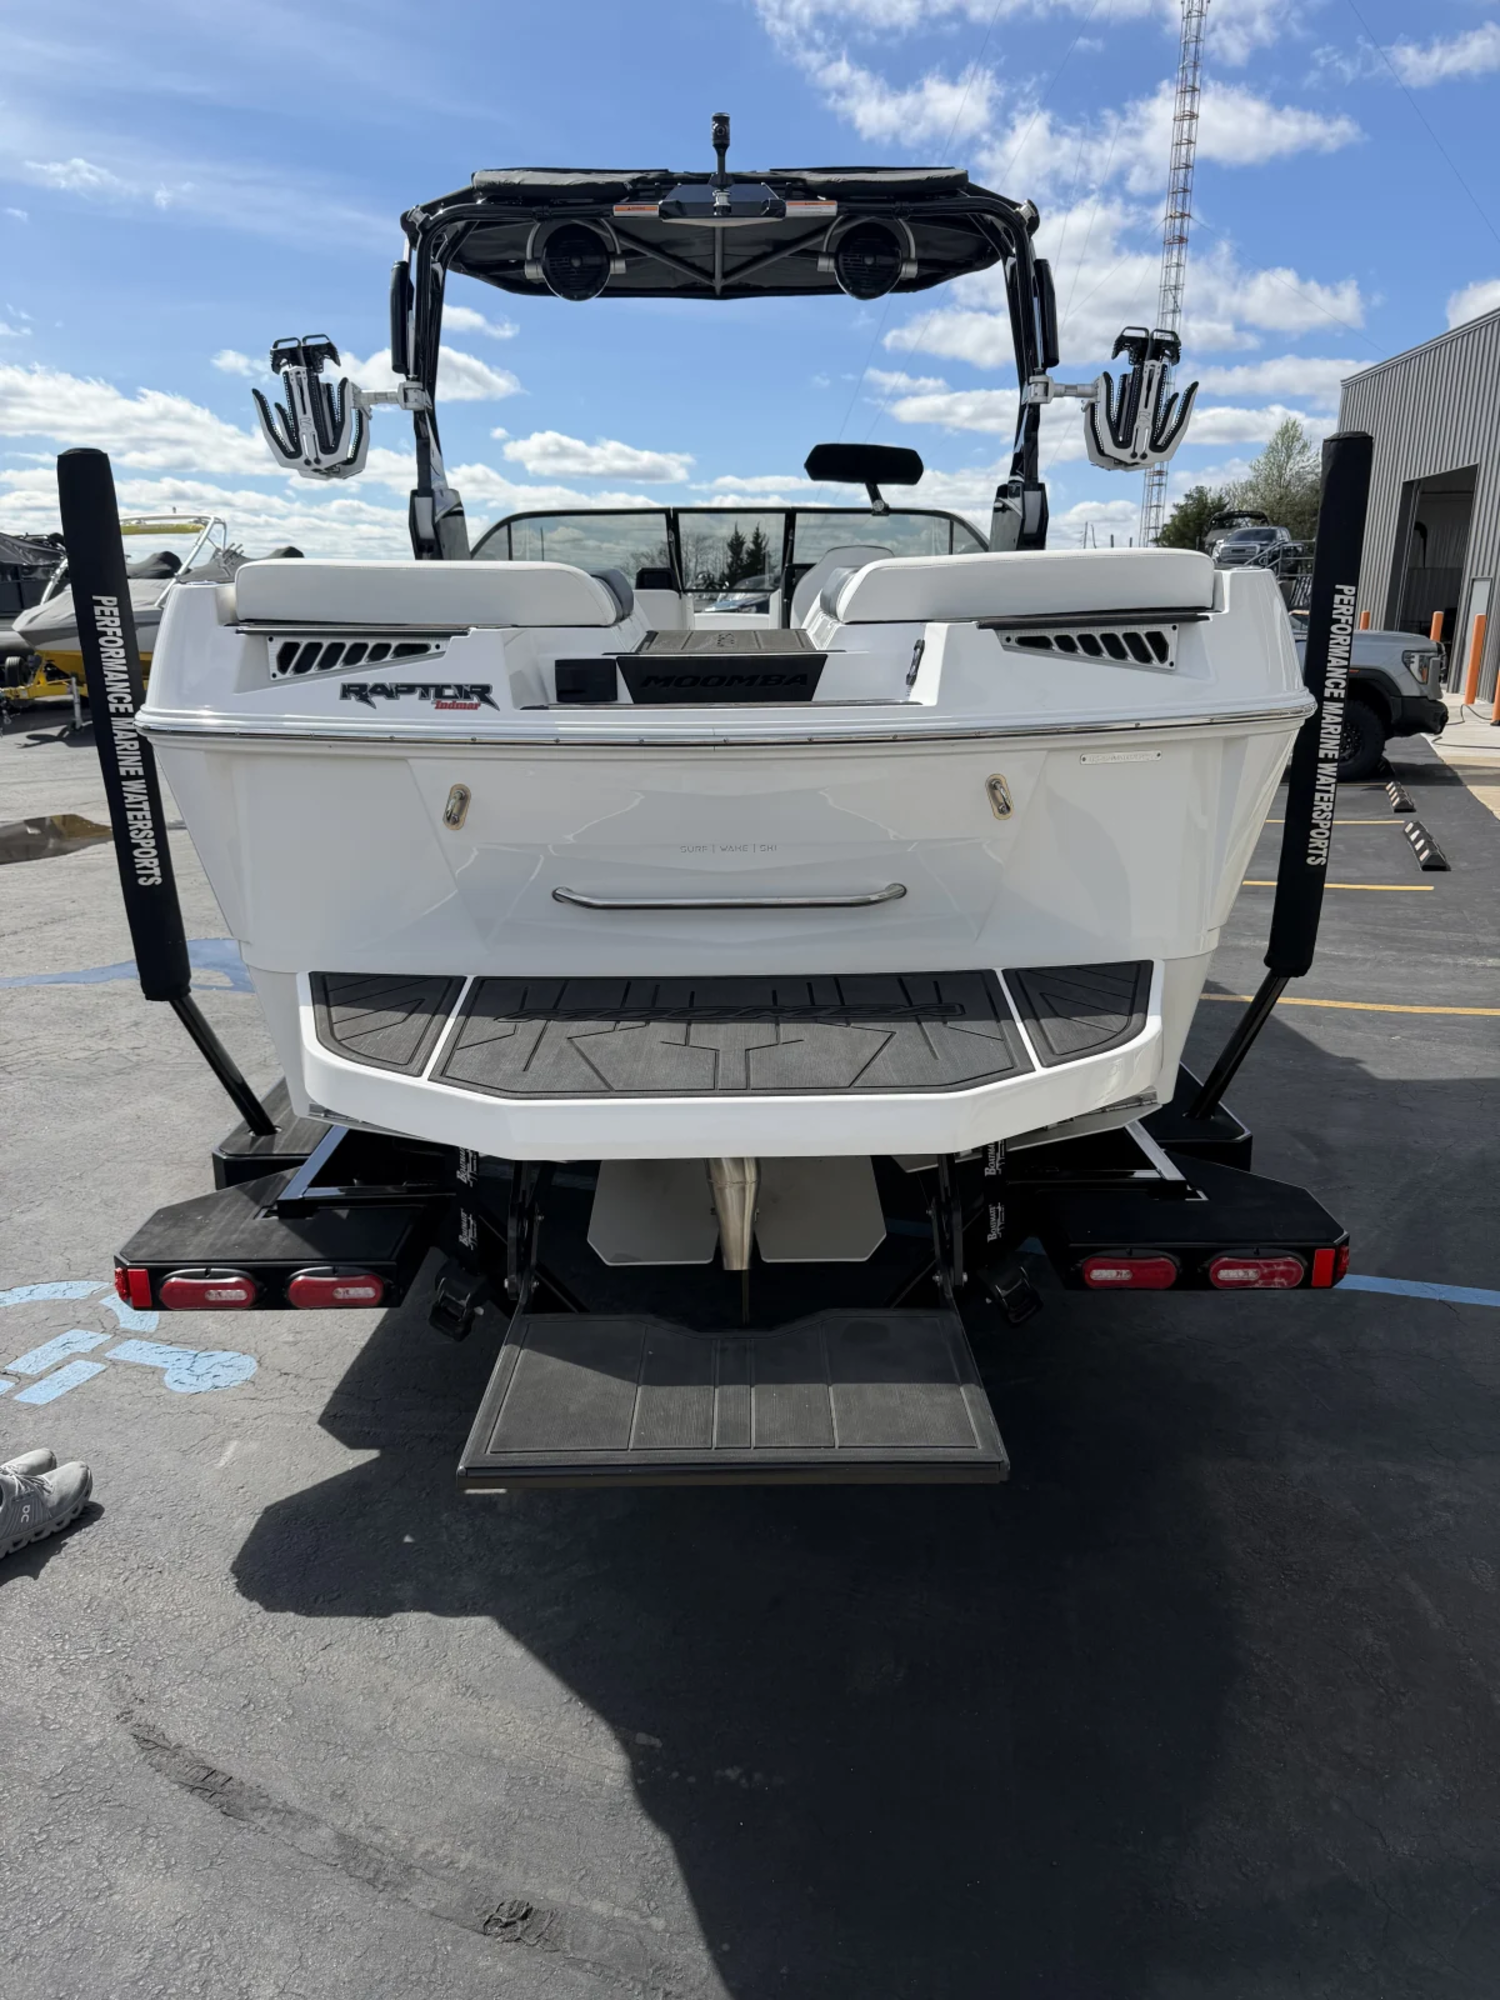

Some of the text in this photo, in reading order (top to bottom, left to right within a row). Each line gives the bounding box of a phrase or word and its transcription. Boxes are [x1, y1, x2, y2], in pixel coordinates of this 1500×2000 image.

[640, 674, 808, 688] MOOMBA
[339, 682, 500, 711] RAPTOR
[433, 700, 481, 711] Indmar
[1306, 584, 1356, 866] PERFORMANCE MARINE WATERSPORTS
[92, 595, 163, 886] PERFORMANCE MARINE WATERSPORTS
[680, 844, 777, 854] SURF WAKE SKI
